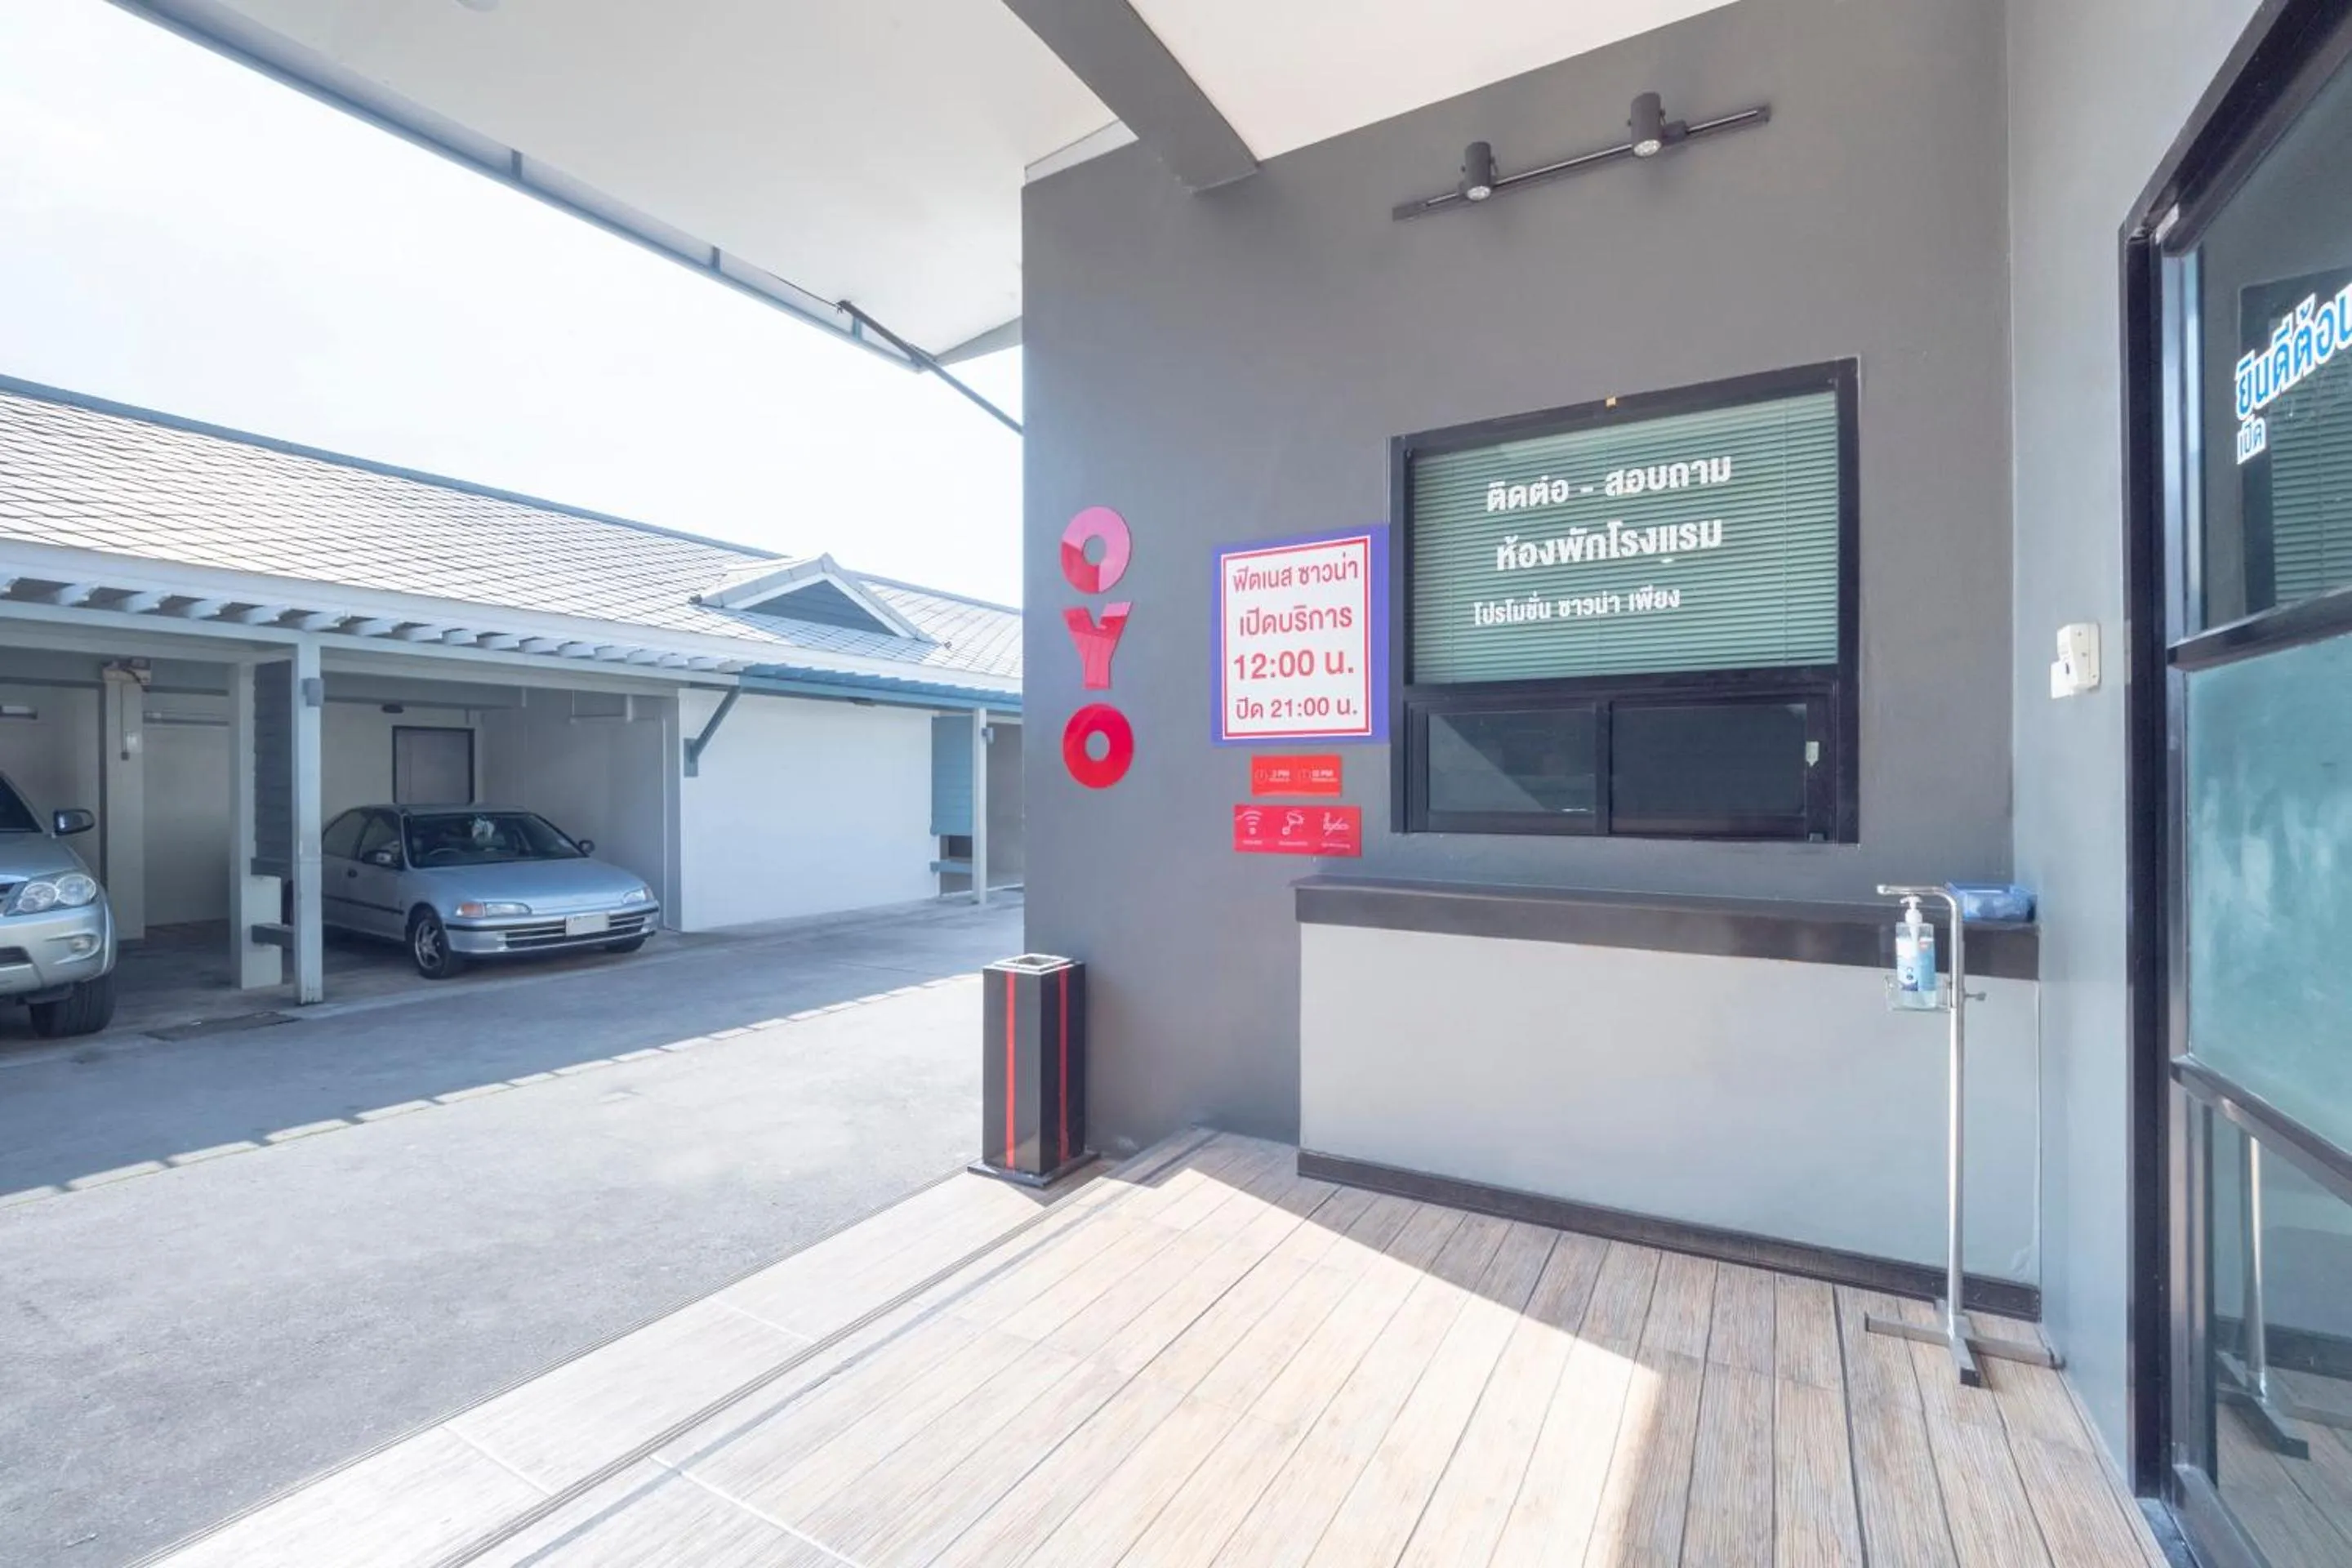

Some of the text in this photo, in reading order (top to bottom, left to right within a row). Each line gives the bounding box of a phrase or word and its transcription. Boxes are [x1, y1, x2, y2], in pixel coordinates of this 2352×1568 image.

[1486, 475, 1570, 512] ติดต่อ
[1605, 456, 1732, 497] สอบถาม
[1496, 519, 1723, 571] ห้องพักโรงแรม
[1298, 551, 1358, 586] ซาวน่า
[1239, 604, 1353, 636] เปิดบริการ
[1473, 590, 1552, 626] โปรโมชั่น
[1628, 585, 1682, 612] เพียง
[1061, 505, 1134, 790] OYO
[1233, 649, 1355, 680] 12:00 น.
[1236, 696, 1358, 719] ปิด 21:00 น.
